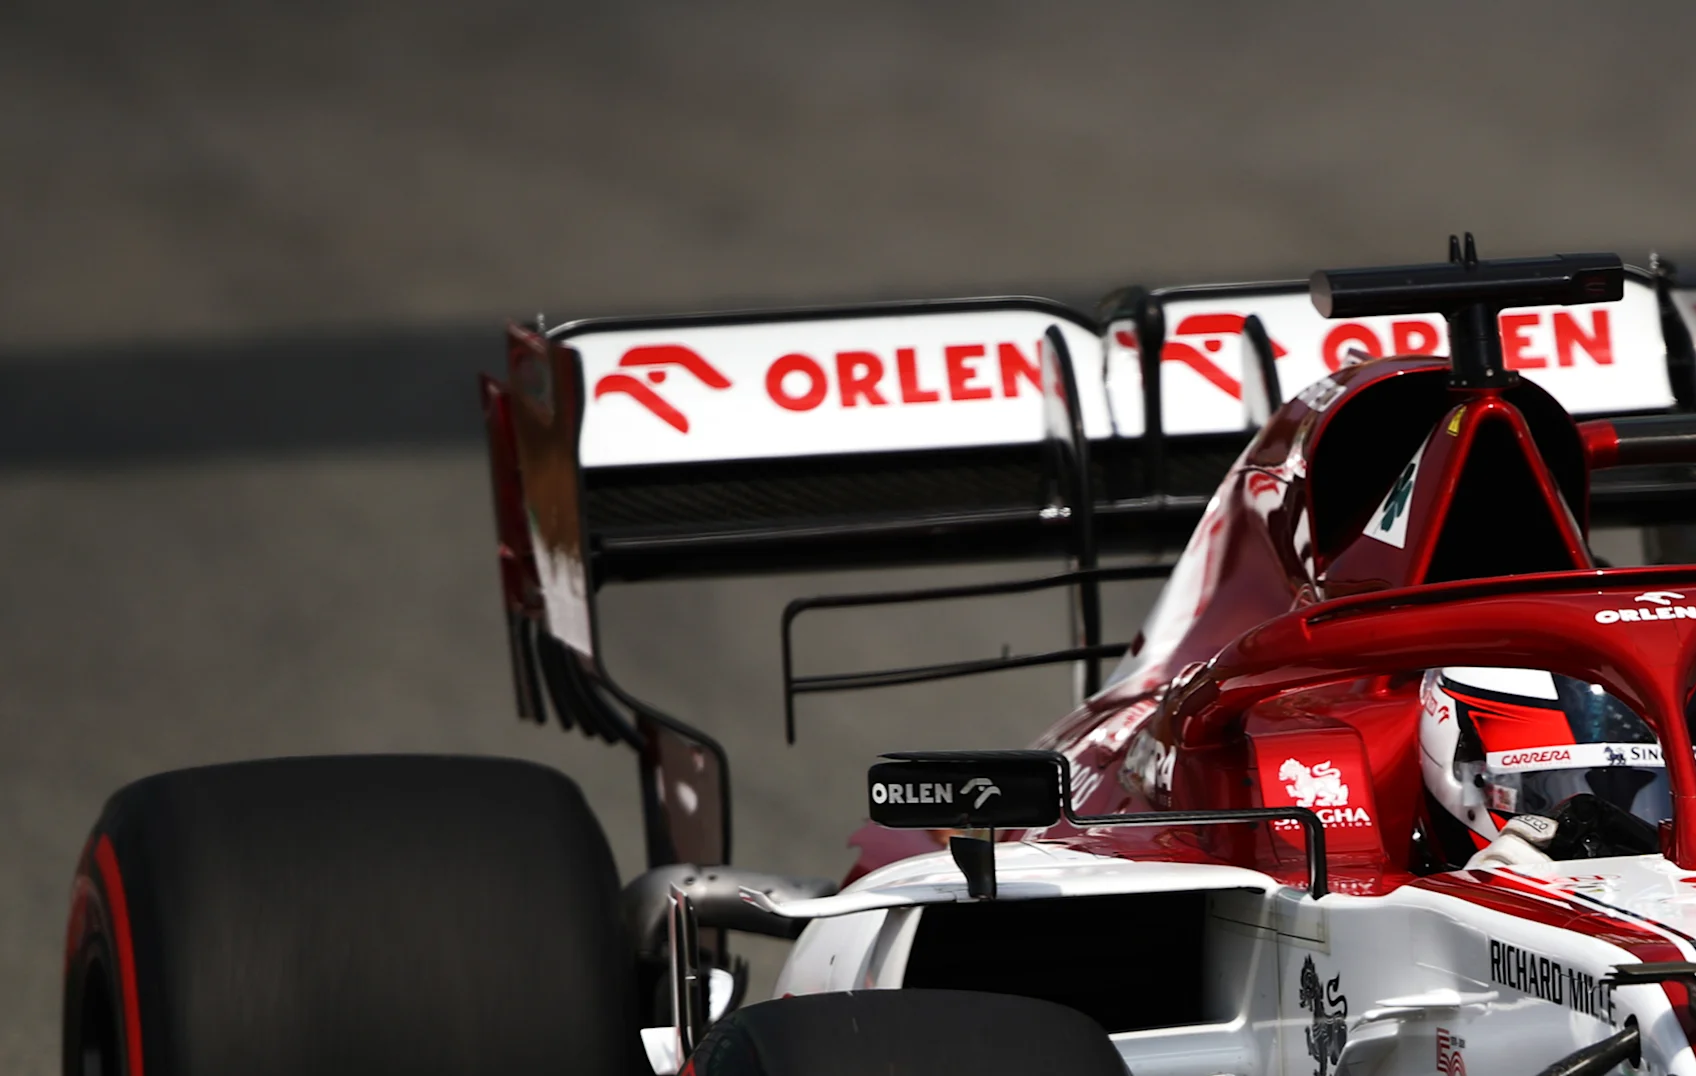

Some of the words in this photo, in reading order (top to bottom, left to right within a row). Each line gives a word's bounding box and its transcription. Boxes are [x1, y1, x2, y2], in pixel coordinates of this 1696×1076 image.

[1322, 309, 1615, 373] OREN
[1501, 750, 1571, 767] CARRERA
[872, 782, 953, 804] ORLEN
[1490, 939, 1563, 1006] RICHARD
